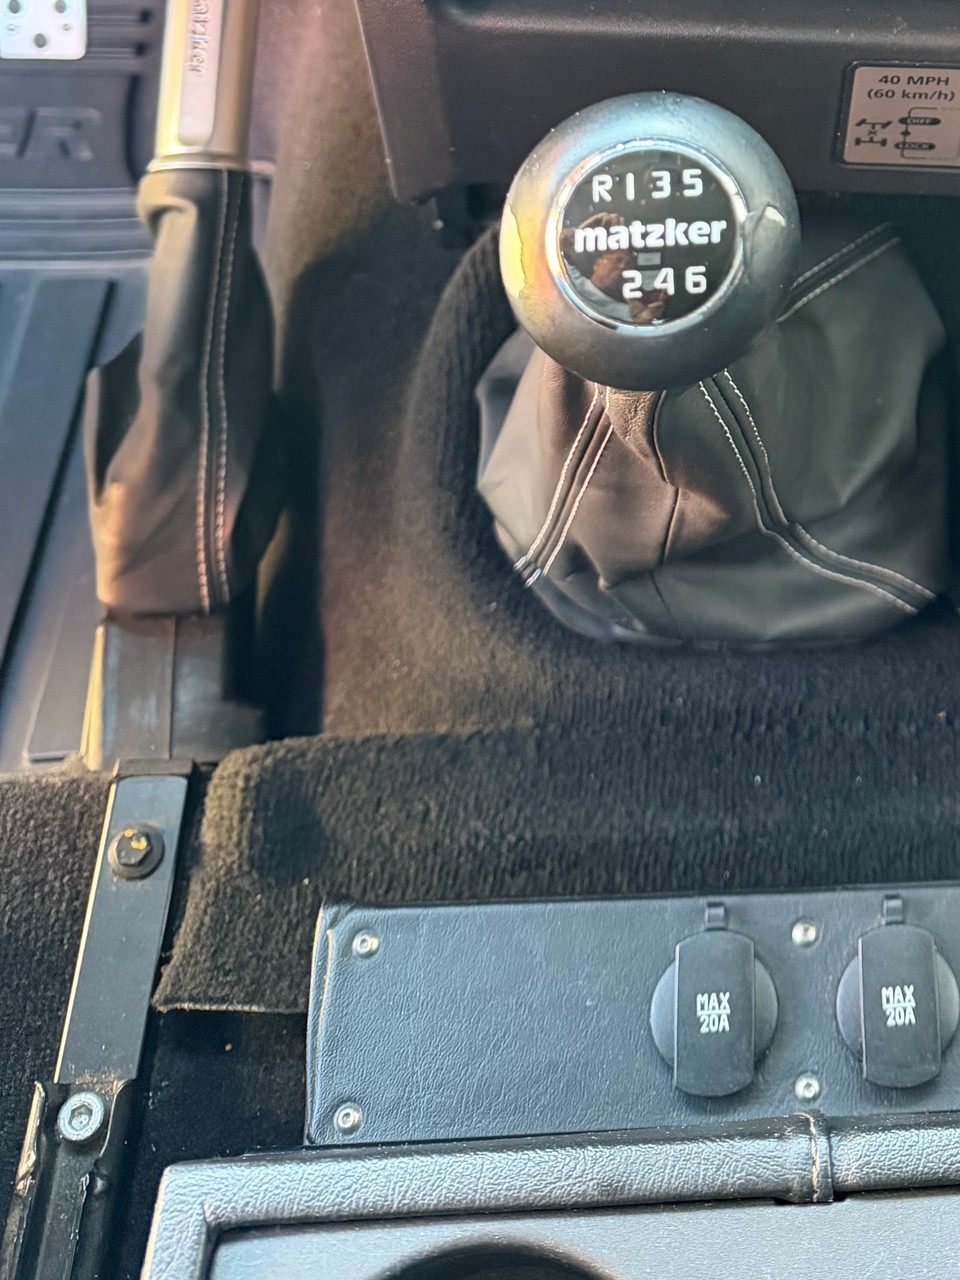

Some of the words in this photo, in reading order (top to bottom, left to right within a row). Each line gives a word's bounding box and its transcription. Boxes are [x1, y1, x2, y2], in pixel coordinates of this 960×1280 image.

[878, 74, 902, 87] 40
[906, 75, 950, 87] MPH
[866, 88, 896, 101] (60
[899, 88, 956, 102] km/h)
[592, 174, 613, 204] R
[651, 170, 671, 200] 3
[682, 168, 704, 198] 5
[573, 218, 728, 254] matzker
[621, 269, 643, 300] 2
[653, 267, 676, 296] 4
[684, 265, 707, 295] 6
[696, 991, 731, 1012] MAX
[881, 984, 915, 1005] MAX
[699, 1014, 730, 1035] 20A
[885, 1007, 916, 1028] 20A
